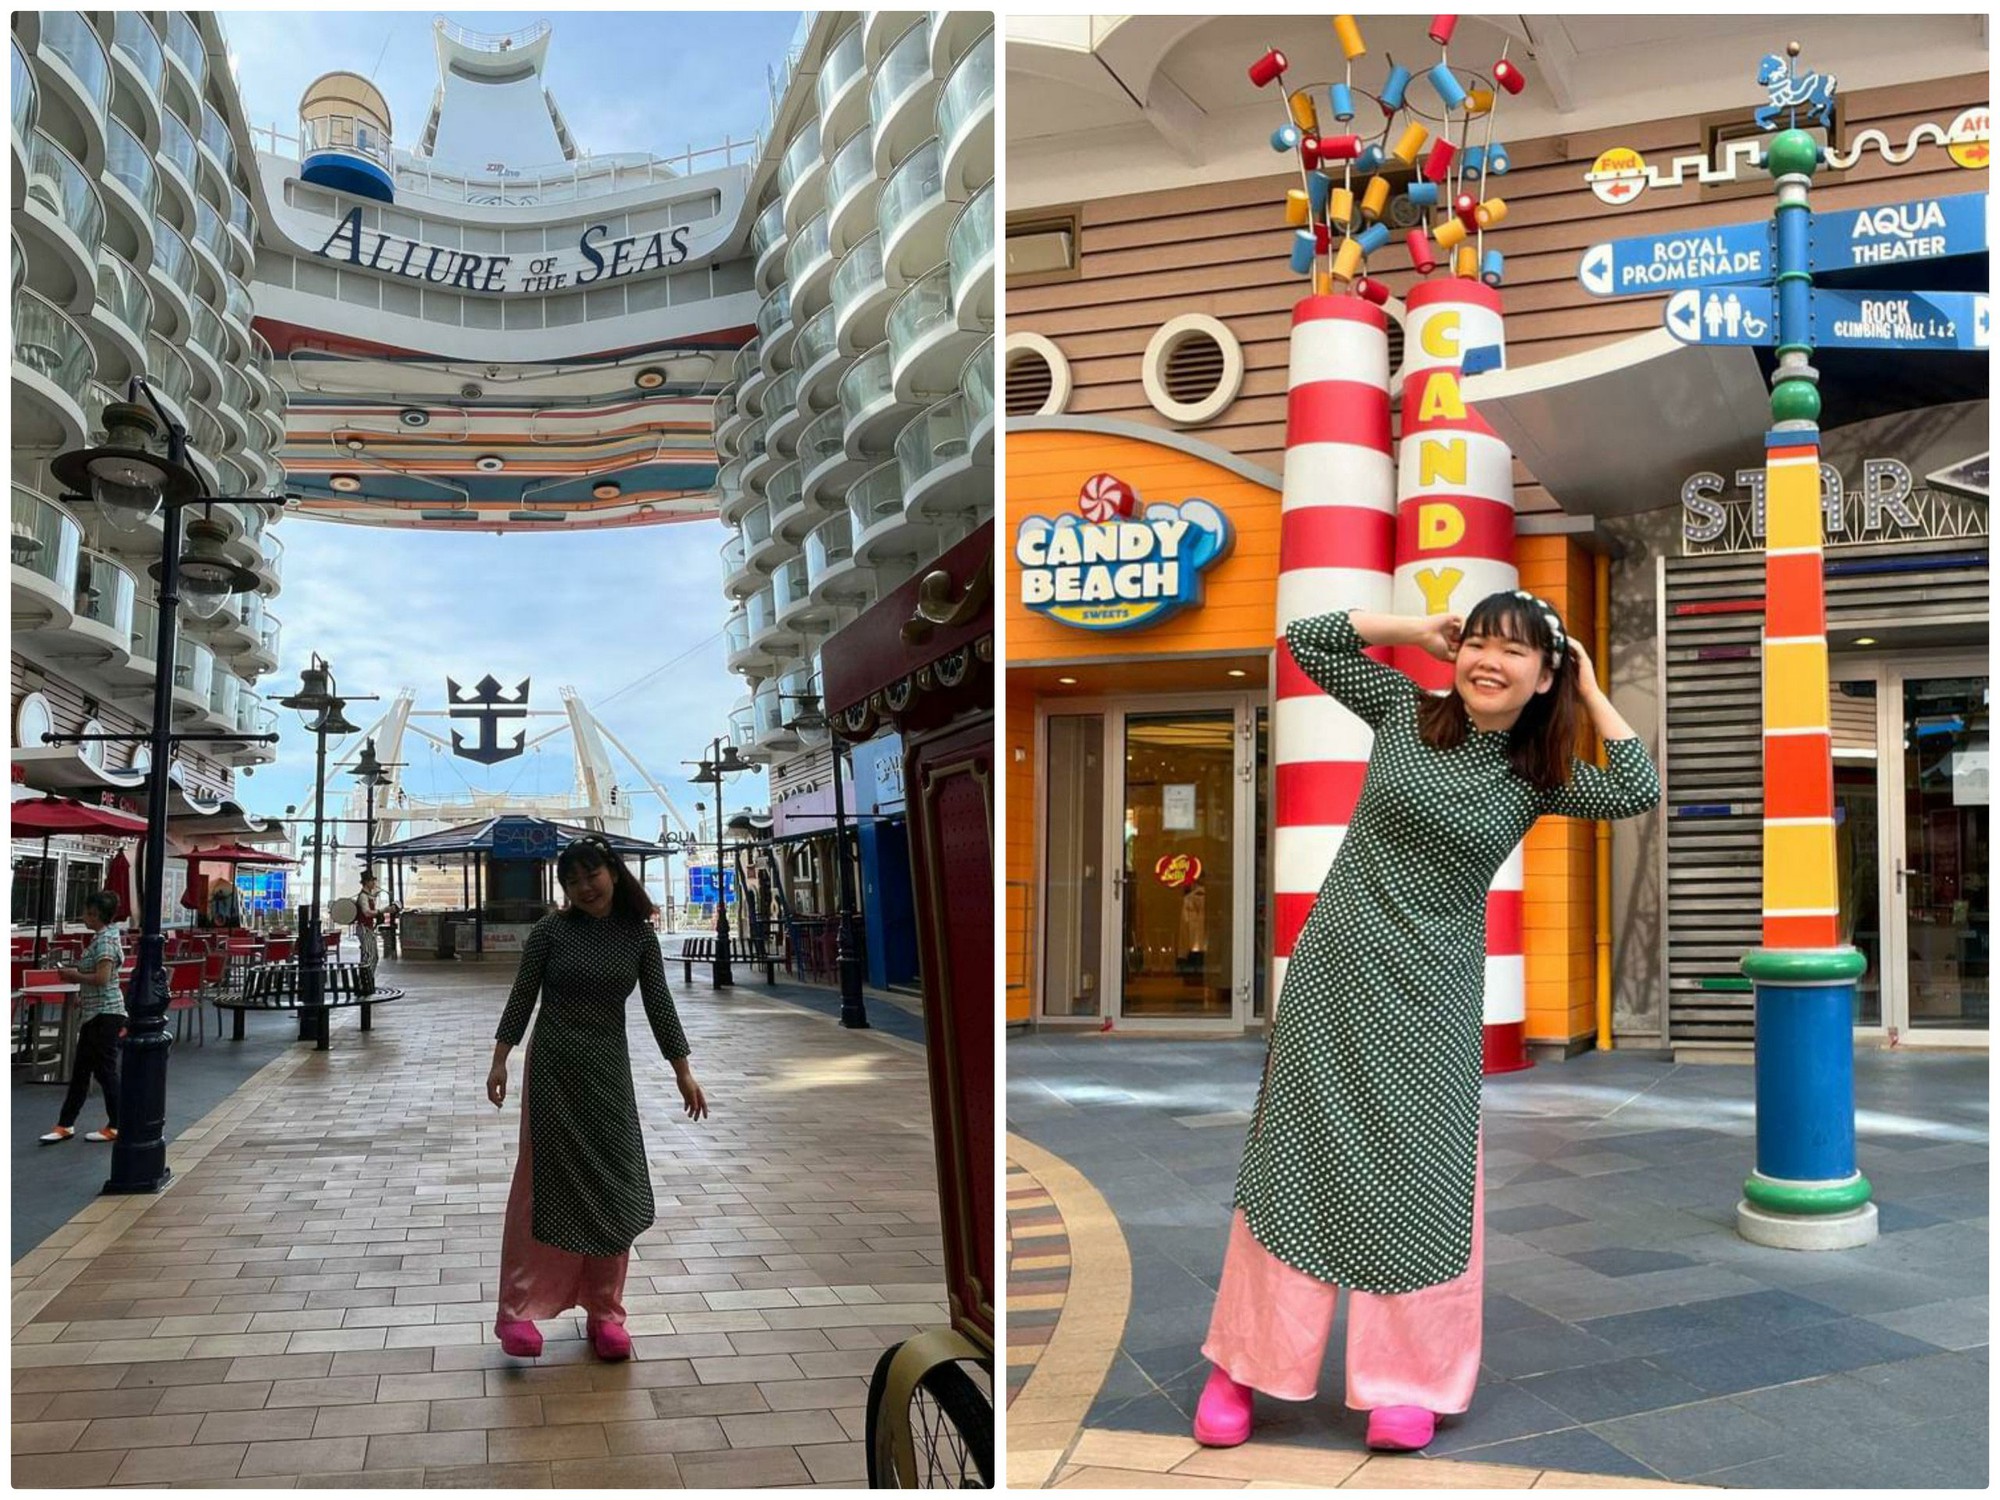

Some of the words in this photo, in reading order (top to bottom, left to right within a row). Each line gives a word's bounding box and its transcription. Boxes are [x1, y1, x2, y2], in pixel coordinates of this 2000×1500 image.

[1601, 156, 1636, 172] Fwd
[1851, 201, 1946, 239] AQUA
[314, 207, 510, 292] ALLURE
[575, 224, 690, 285] SEAS
[1653, 236, 1728, 262] ROYAL
[1851, 235, 1946, 264] THEATER
[529, 257, 557, 275] OF
[1623, 251, 1761, 285] PROMENADE
[521, 273, 567, 292] THE
[1861, 299, 1911, 323] ROCK
[1834, 321, 1891, 338] CLIMBING
[1893, 321, 1926, 340] WALL
[1928, 319, 1936, 336] 1
[1946, 321, 1956, 337] 2
[1414, 310, 1467, 616] CANDY
[1018, 520, 1189, 566] CANDY
[1021, 561, 1179, 604] BEACH
[1082, 608, 1129, 620] SWEETS
[658, 831, 697, 844] AQUA
